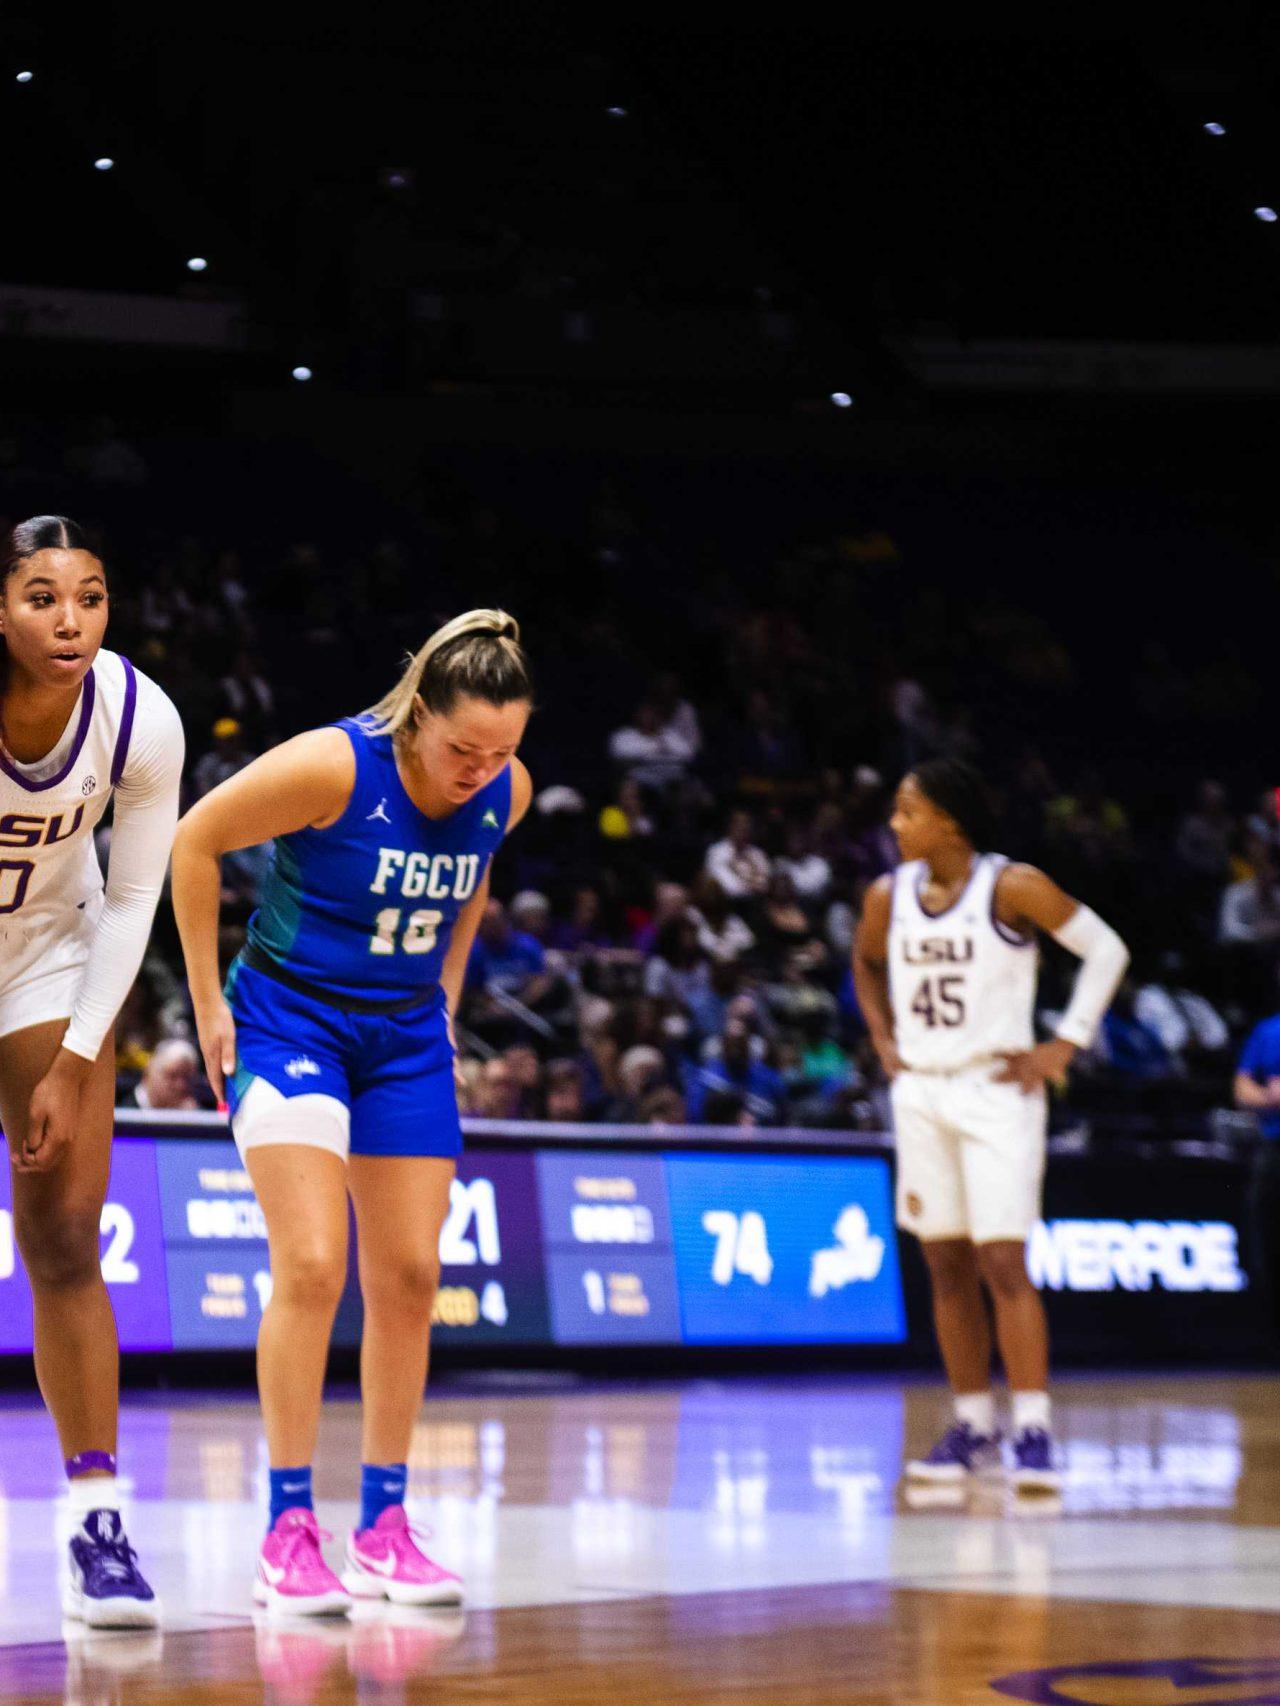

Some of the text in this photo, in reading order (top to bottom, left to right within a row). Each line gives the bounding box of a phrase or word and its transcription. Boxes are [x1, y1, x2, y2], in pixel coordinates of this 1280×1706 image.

[369, 847, 480, 899] FGCU
[903, 937, 973, 965] LSU
[912, 974, 966, 1028] 45
[702, 1209, 774, 1285] 74
